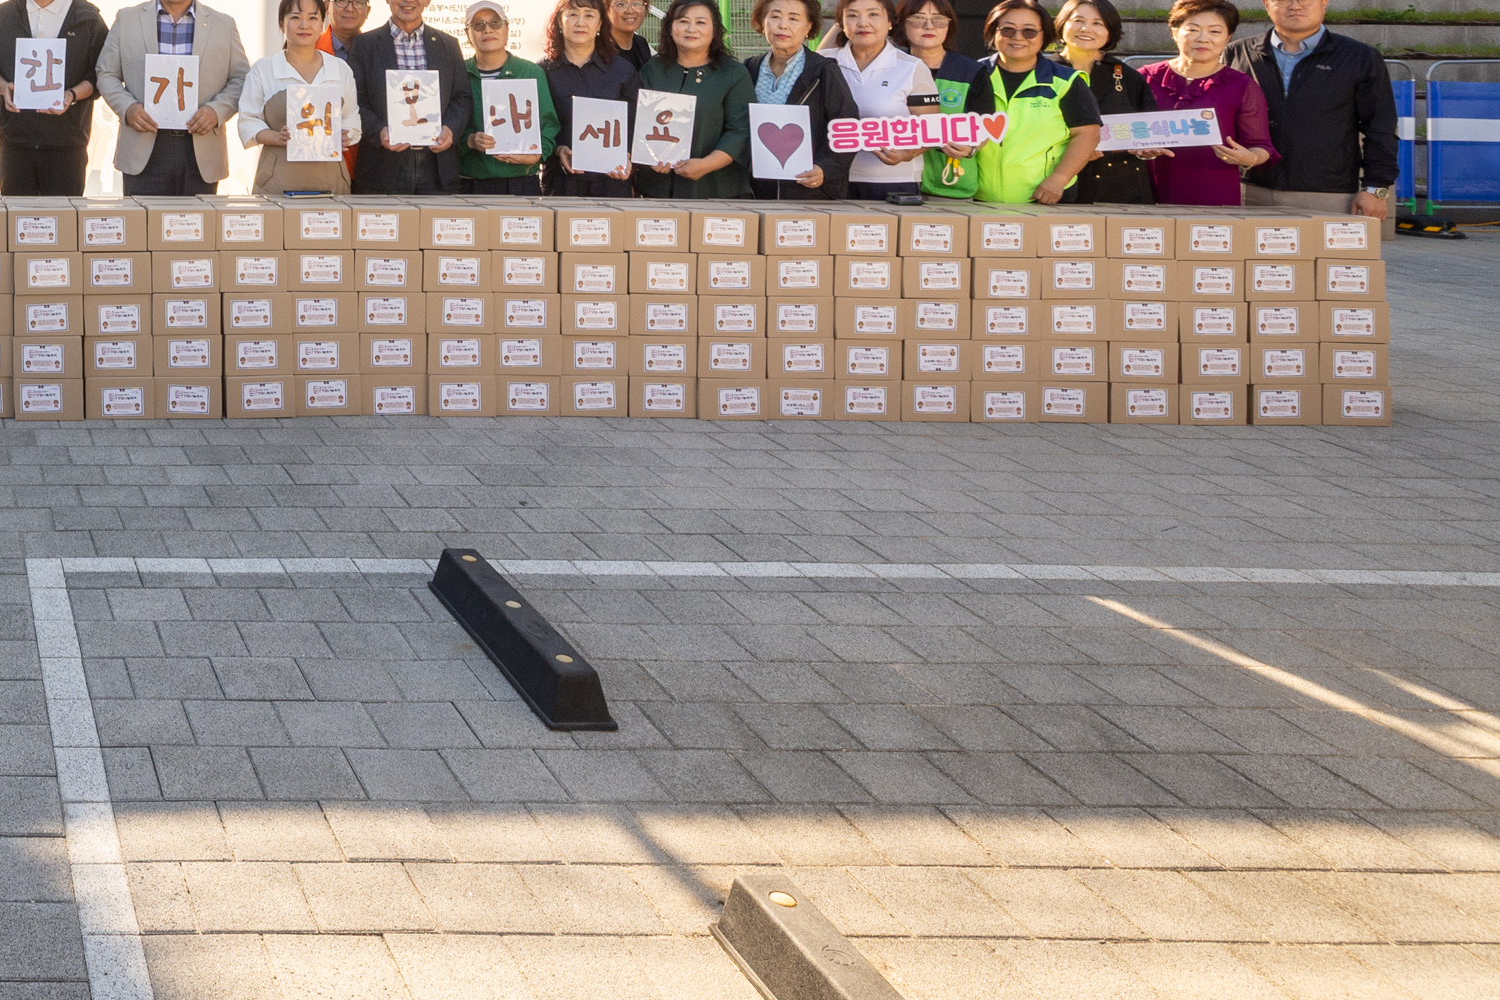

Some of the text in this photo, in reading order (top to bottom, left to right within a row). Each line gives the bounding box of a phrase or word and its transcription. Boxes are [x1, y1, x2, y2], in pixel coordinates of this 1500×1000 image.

[19, 48, 63, 93] 한
[149, 66, 193, 111] 가
[296, 100, 332, 137] 위
[401, 80, 430, 127] 보
[490, 92, 532, 134] 내
[578, 118, 622, 149] 세
[645, 110, 680, 144] 요
[831, 115, 980, 148] 응원합니다
